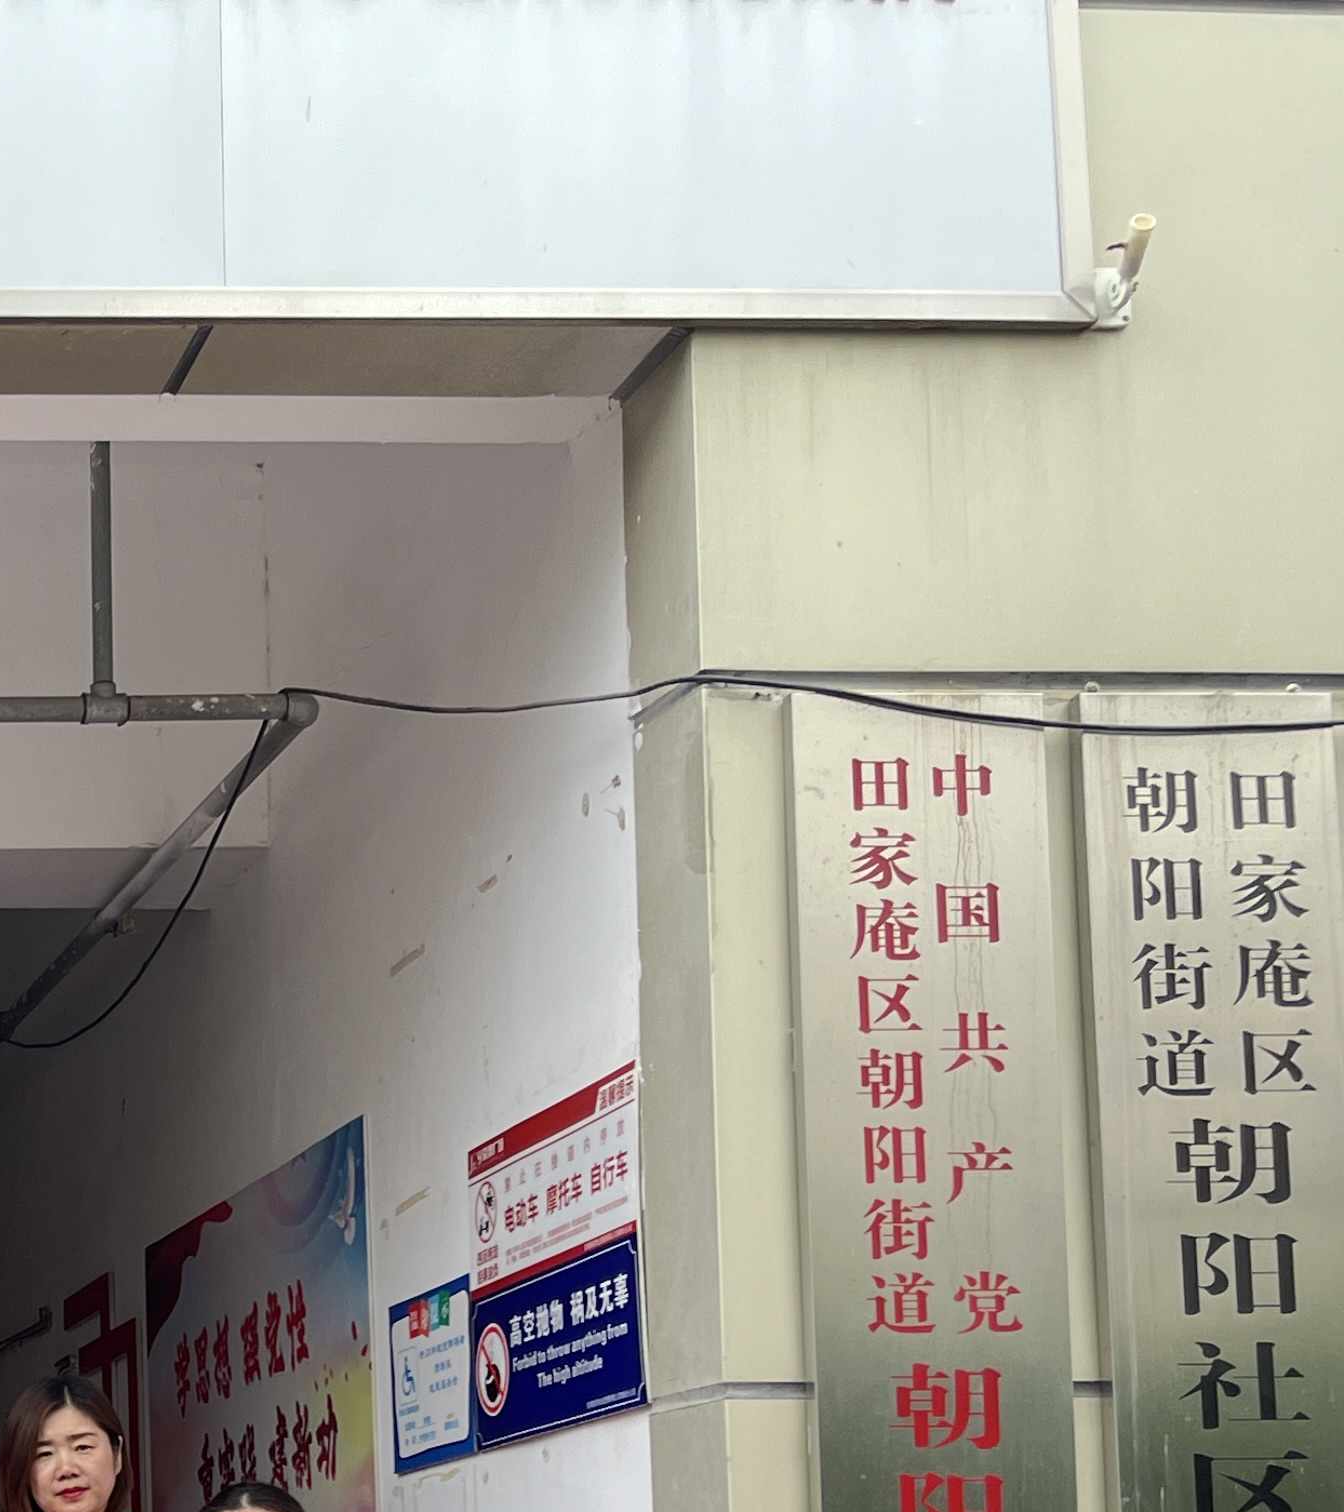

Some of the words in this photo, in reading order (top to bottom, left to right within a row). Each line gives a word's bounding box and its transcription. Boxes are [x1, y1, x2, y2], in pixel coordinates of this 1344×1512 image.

[1122, 766, 1216, 1097] 朝阳街道
[1229, 769, 1317, 1095] 田家庵区
[848, 756, 935, 1335] 田家庵区朝阳街道
[931, 753, 1024, 1334] 中国共产党
[505, 1193, 540, 1233] 电动车
[546, 1173, 583, 1215] 摩托车
[591, 1150, 629, 1195] 自行车
[508, 1299, 565, 1348] 高空抛物
[570, 1272, 630, 1326] 祸及无辜
[512, 1351, 537, 1372] Forbid
[538, 1350, 546, 1364] to
[547, 1344, 570, 1361] throw
[572, 1329, 607, 1352] anything
[608, 1322, 628, 1339] from
[537, 1371, 552, 1388] The
[553, 1364, 571, 1385] high
